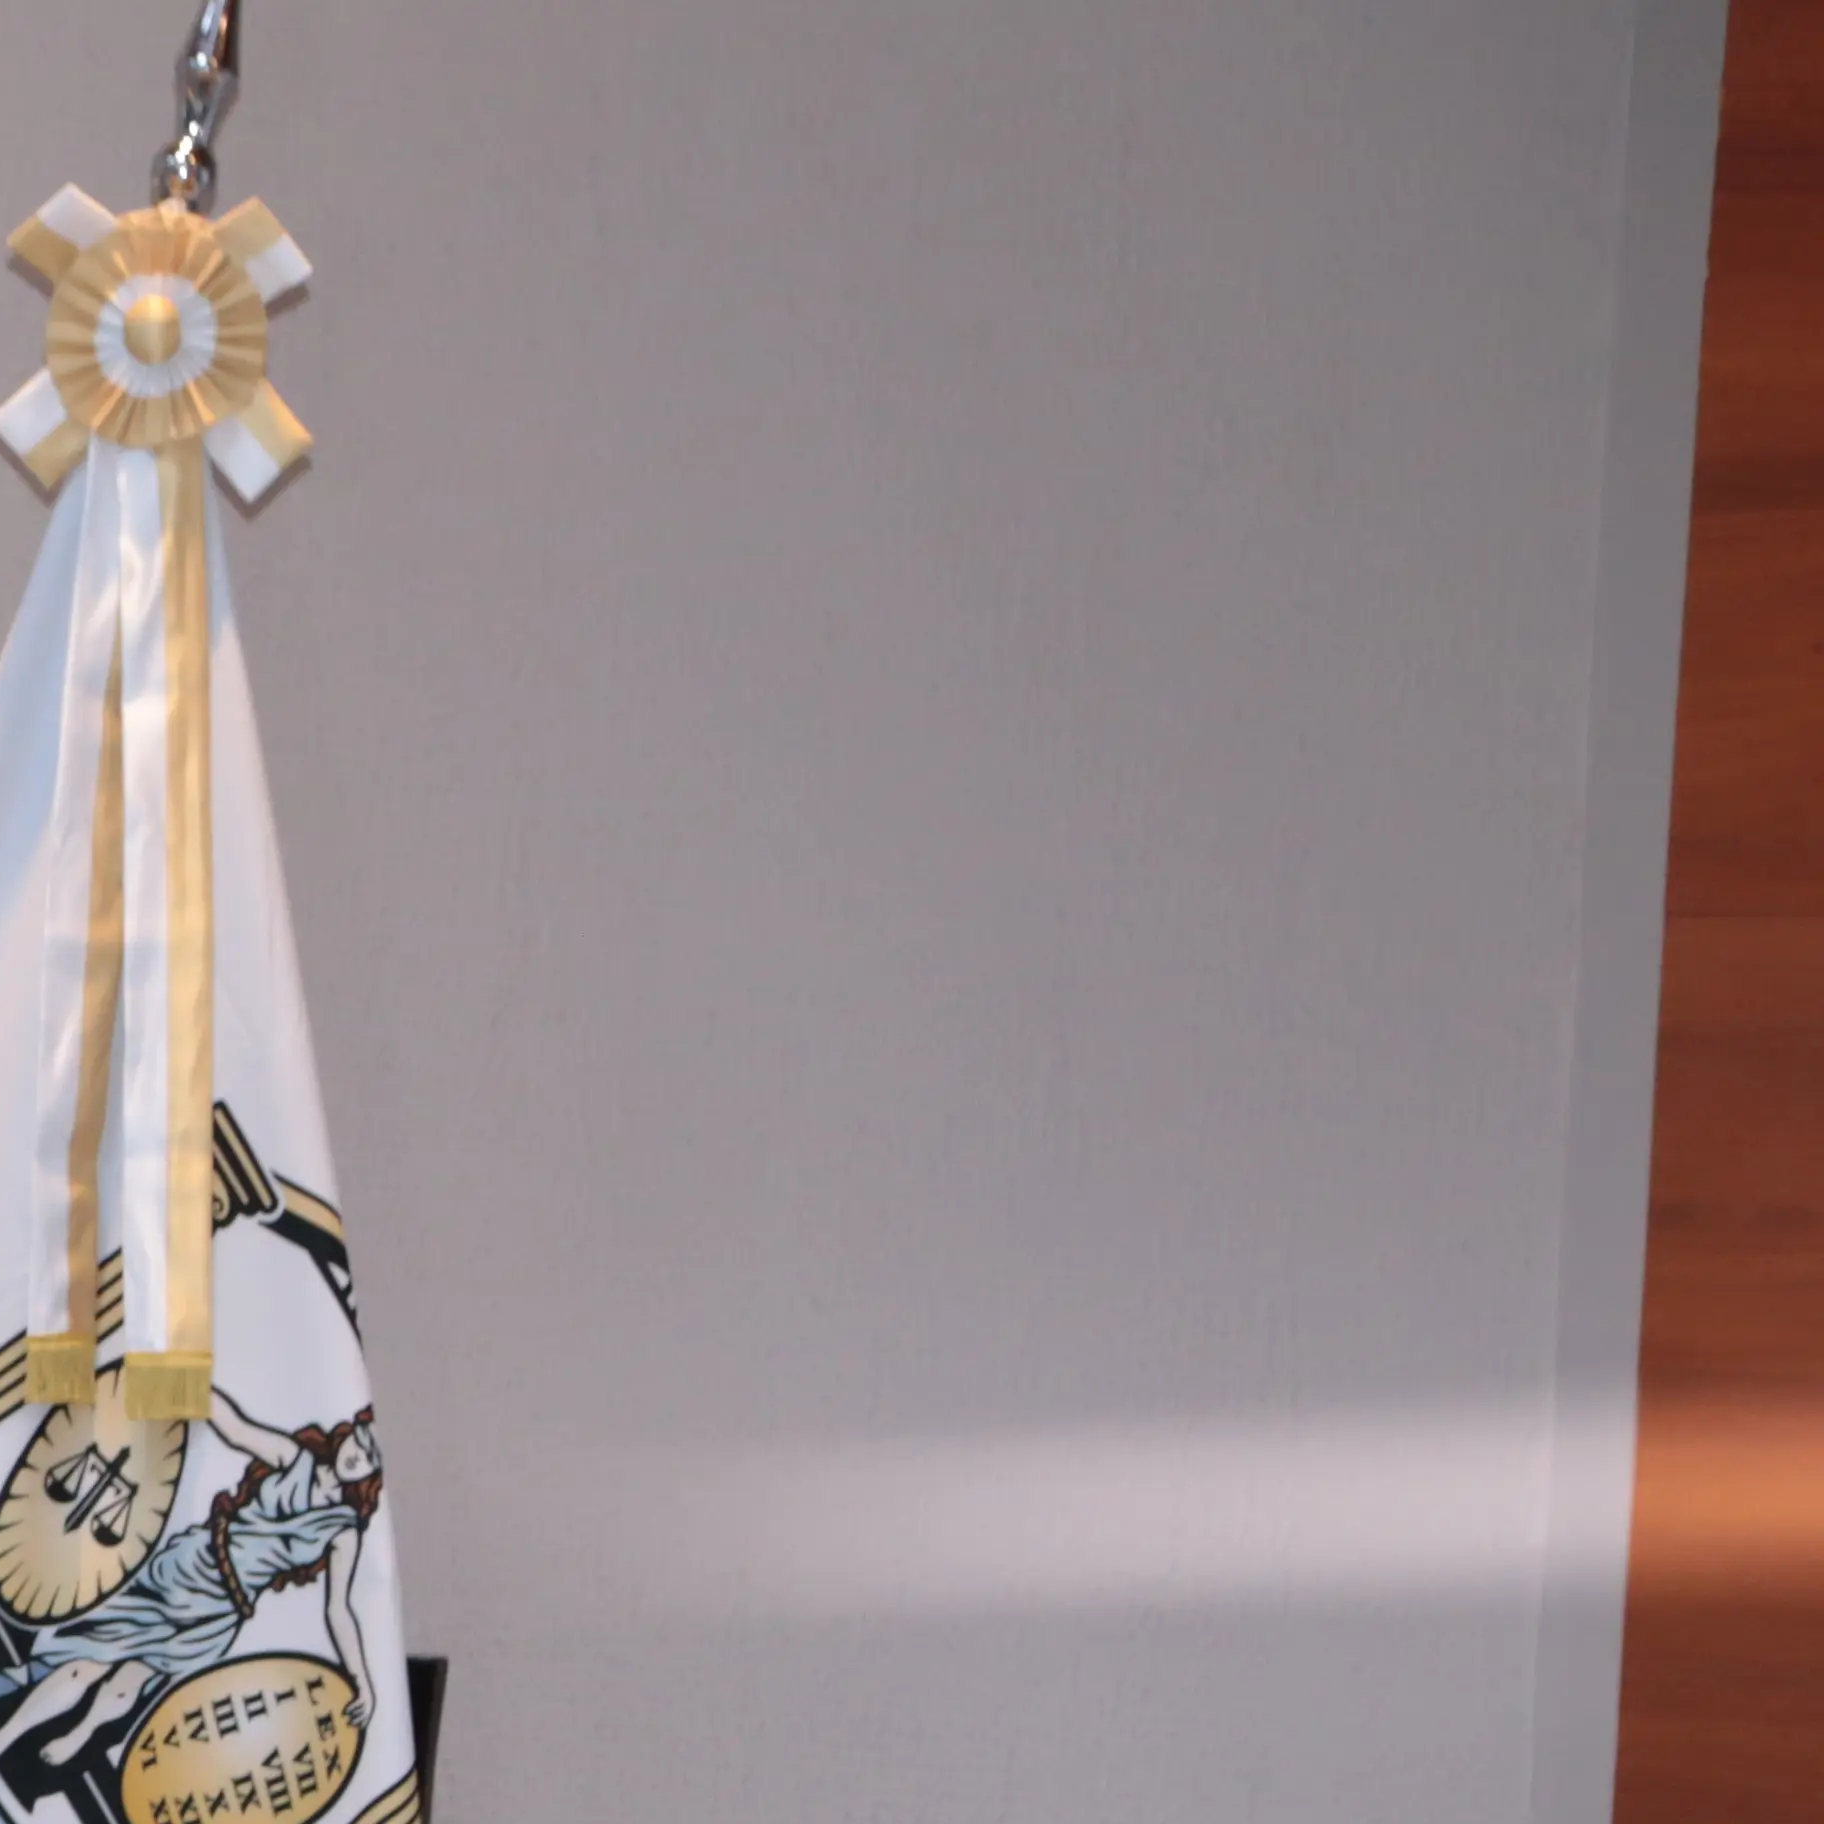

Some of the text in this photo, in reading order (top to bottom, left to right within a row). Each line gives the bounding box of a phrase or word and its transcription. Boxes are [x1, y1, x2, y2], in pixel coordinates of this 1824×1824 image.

[212, 1693, 240, 1739] III
[242, 1690, 268, 1722] II
[274, 1685, 296, 1704] I
[163, 1724, 181, 1748] V
[183, 1706, 210, 1743] IV
[305, 1675, 343, 1780] LEX
[140, 1729, 158, 1773] VI
[293, 1742, 318, 1798] VII
[204, 1788, 231, 1818] X
[231, 1771, 262, 1815] IX
[261, 1745, 293, 1818] VIII
